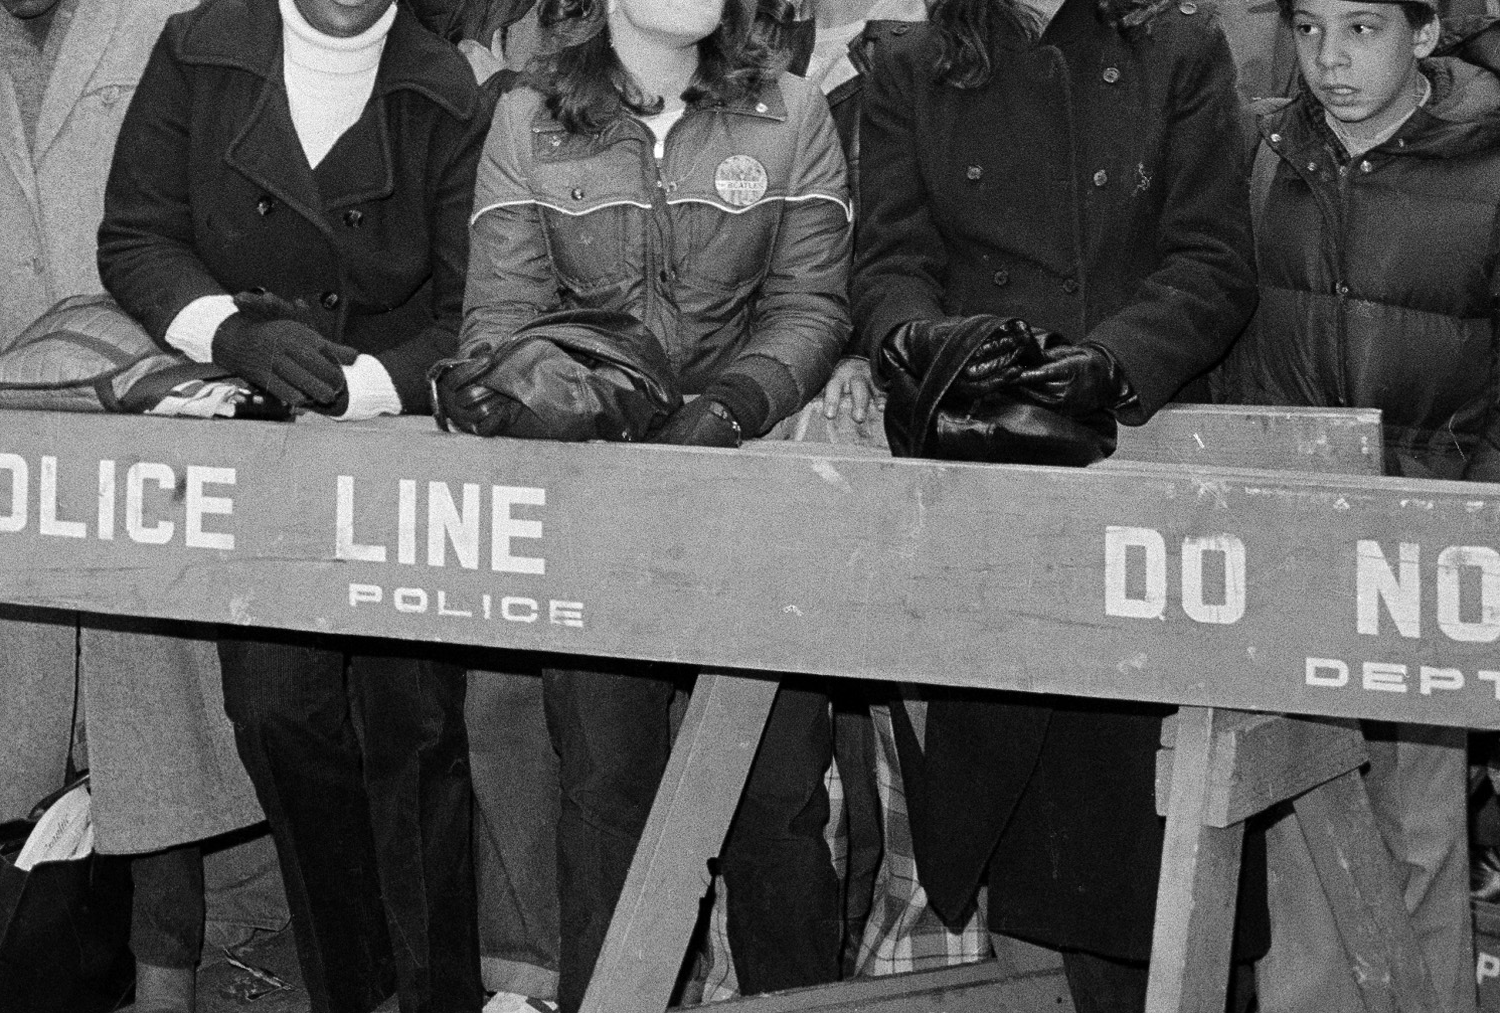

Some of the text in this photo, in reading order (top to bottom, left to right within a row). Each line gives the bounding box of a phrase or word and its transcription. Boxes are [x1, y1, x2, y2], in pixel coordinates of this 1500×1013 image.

[335, 474, 546, 575] LINE
[349, 582, 584, 628] POLICE
[1104, 525, 1247, 625] DO
